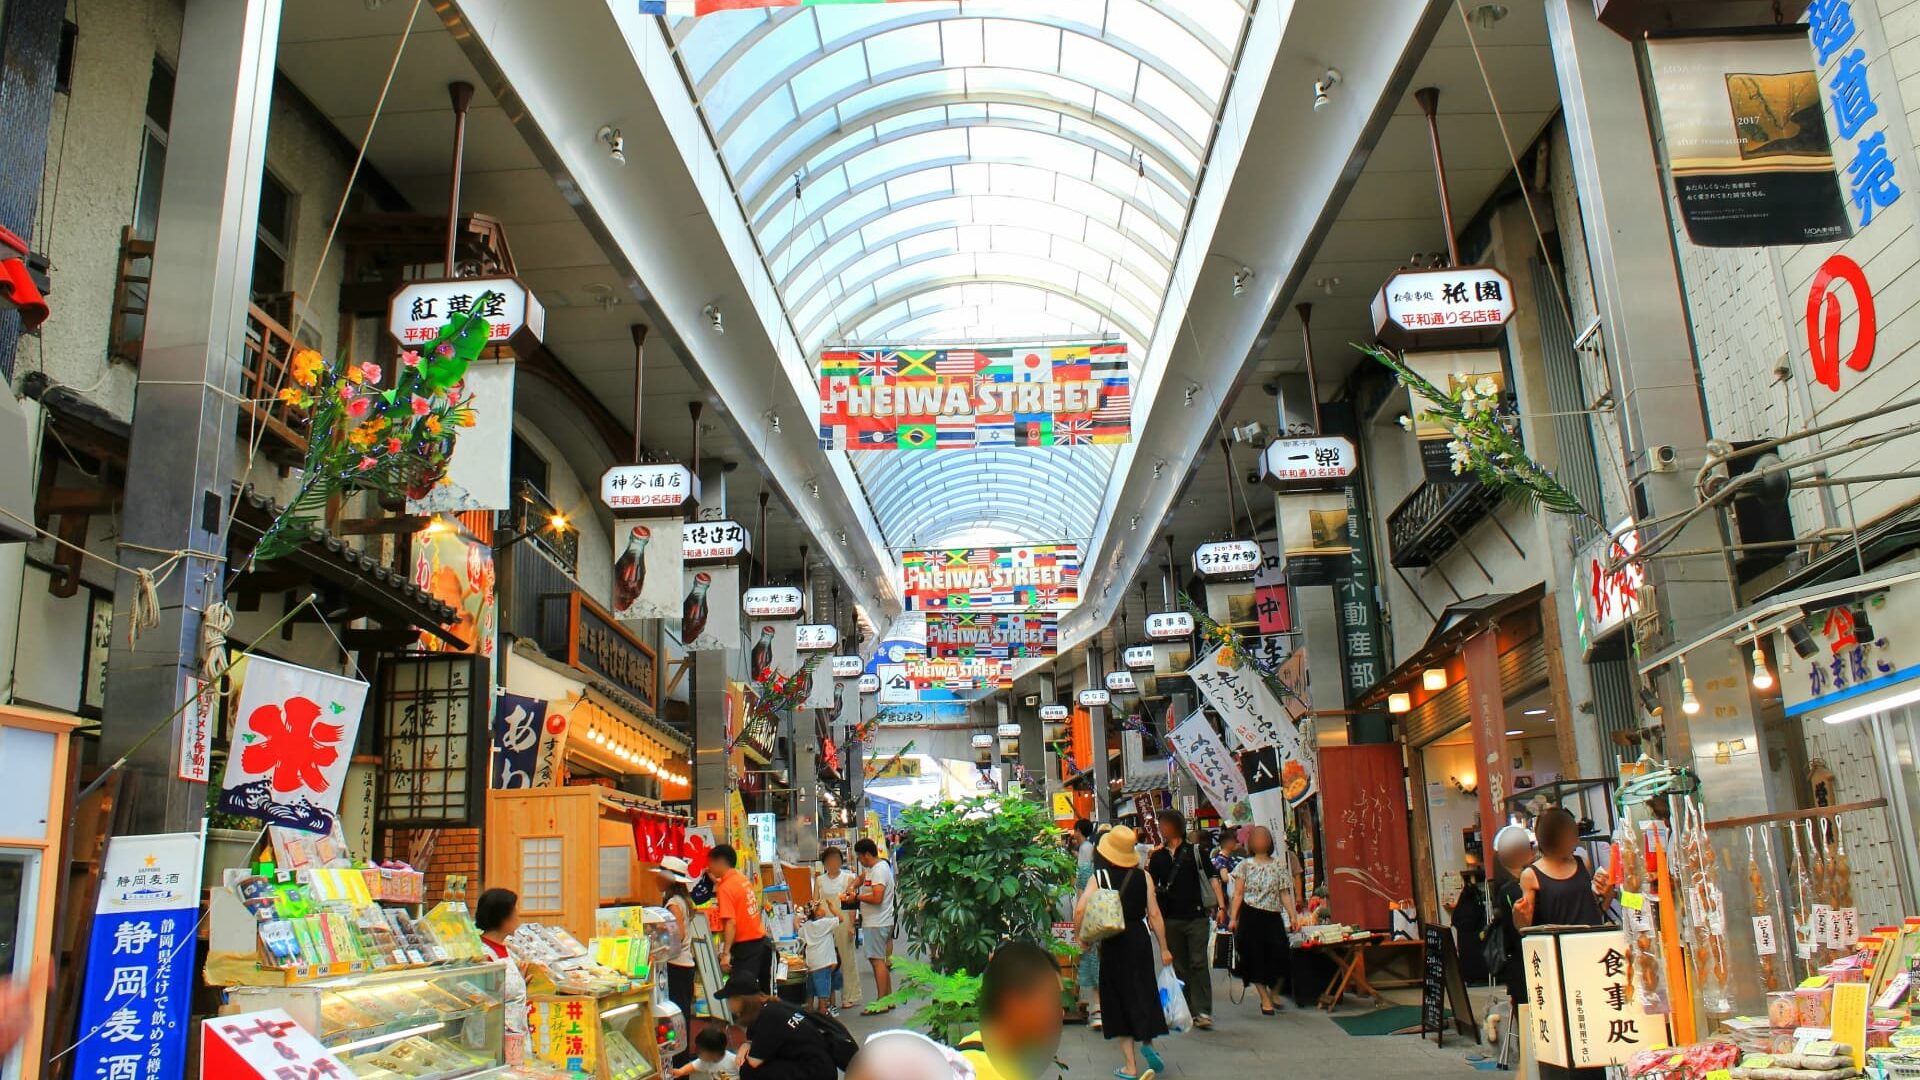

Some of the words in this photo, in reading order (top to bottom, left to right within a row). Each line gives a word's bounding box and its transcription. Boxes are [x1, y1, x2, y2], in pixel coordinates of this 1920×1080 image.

[1736, 116, 1760, 125] 2017
[1401, 309, 1502, 327] 平和通り名店街
[848, 382, 974, 416] HEIWA
[974, 378, 1104, 415] STREET
[612, 472, 682, 490] 神谷酒店
[1279, 467, 1346, 478] 平和通り名店街
[610, 494, 682, 505] 平和通り名店街
[918, 569, 991, 590] HEIWA
[991, 565, 1063, 587] STREET
[1153, 614, 1187, 628] 食事処
[936, 629, 991, 645] HEIWA
[991, 626, 1047, 644] STREET
[916, 663, 959, 679] HEIWA
[958, 661, 1002, 678] STREET
[1808, 637, 1892, 696] かまぼこ
[241, 696, 345, 794] 氷
[116, 873, 180, 888] 静岡麦酒
[96, 921, 158, 1080] 静岡麦酒
[145, 919, 175, 1080] 静岡県だけで飲める樽
[1531, 949, 1550, 1043] 食事処
[1598, 947, 1640, 1044] 食事処
